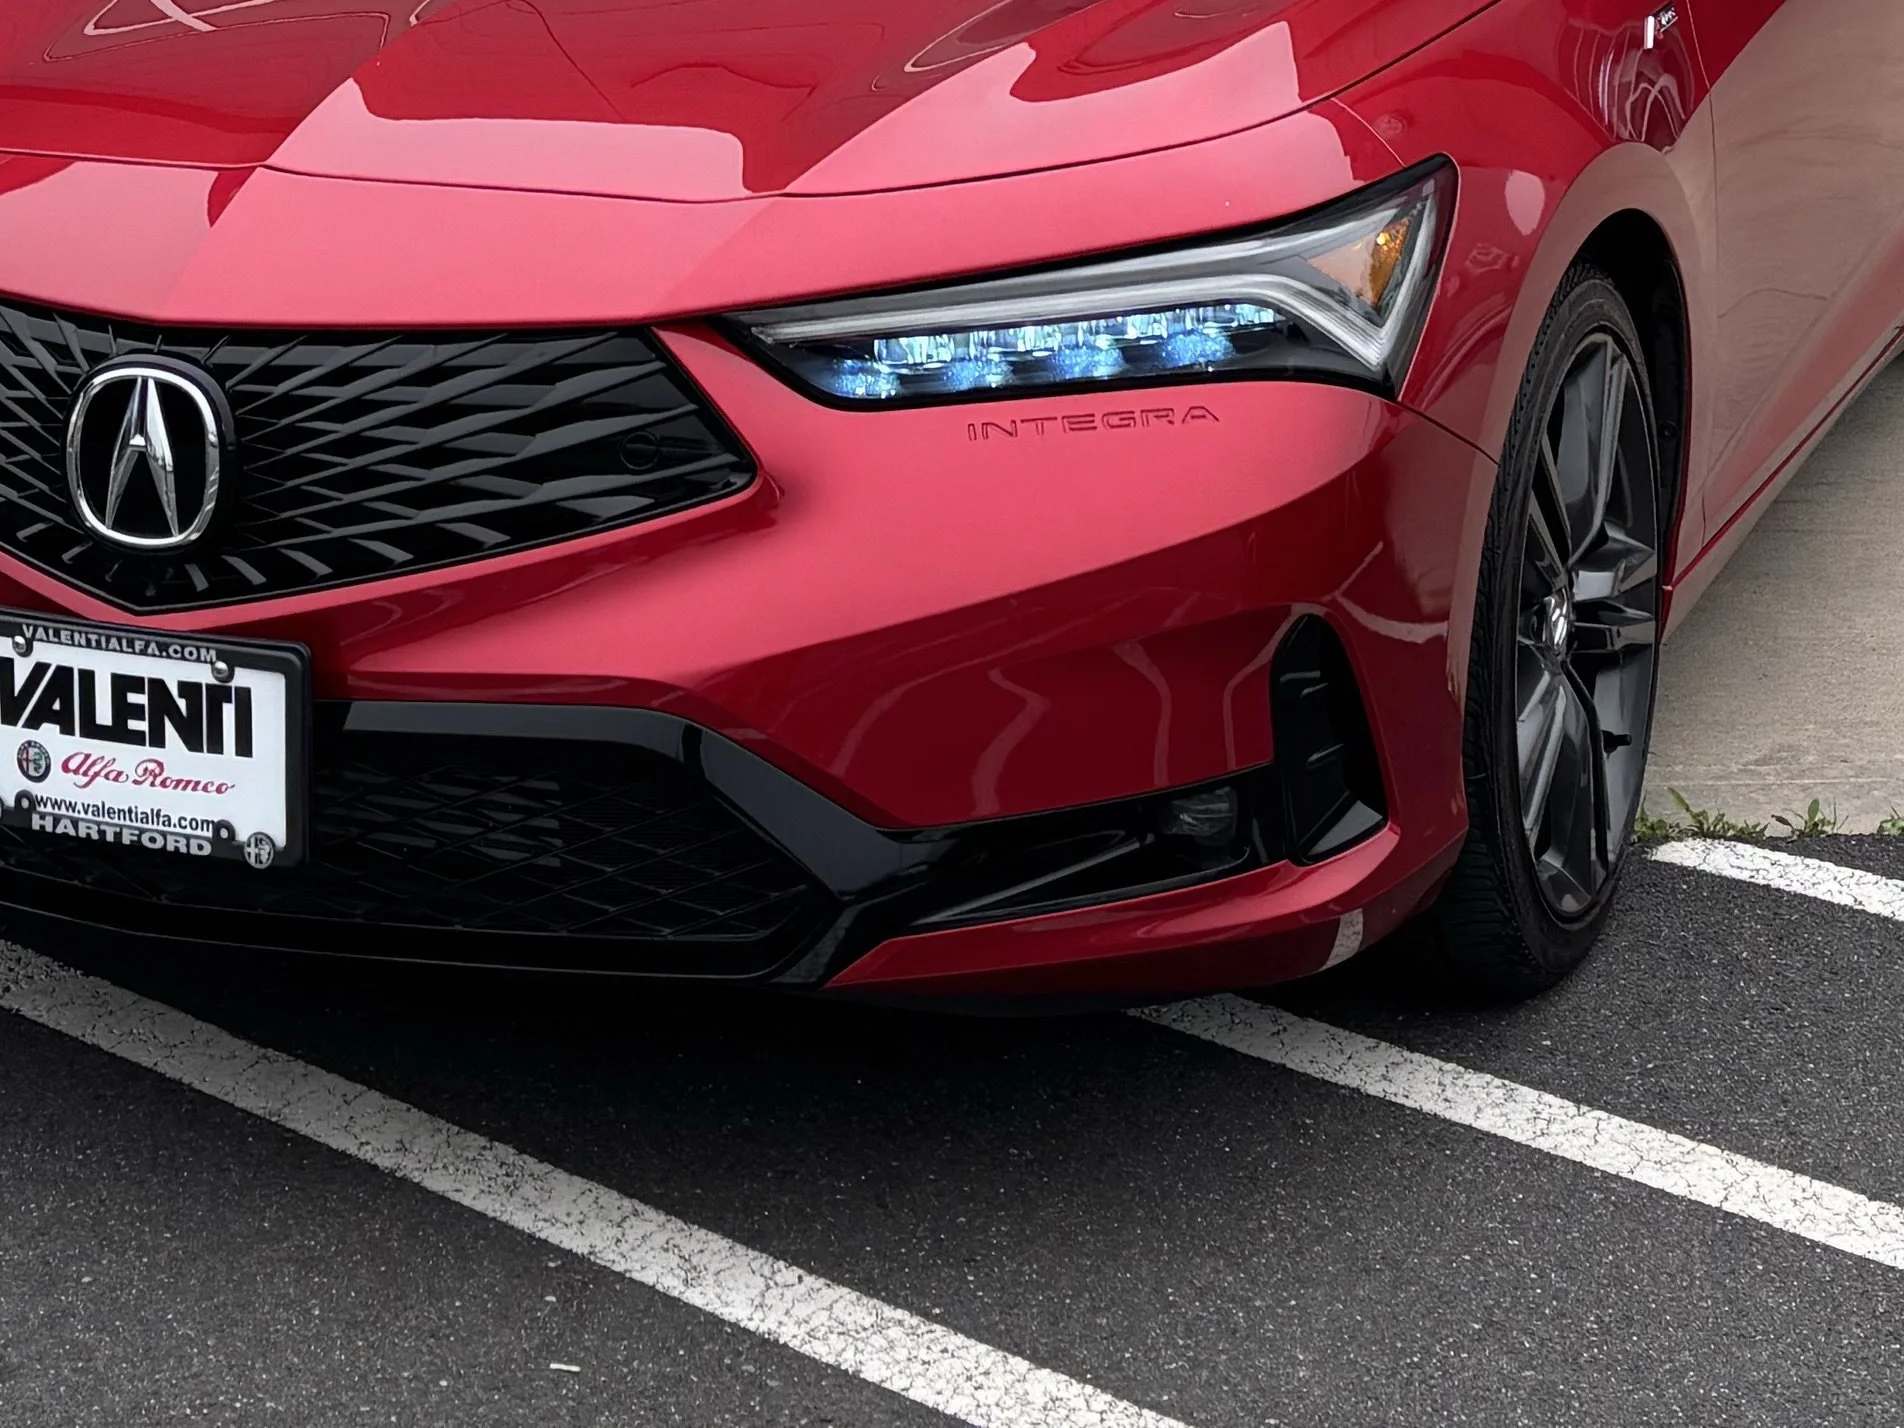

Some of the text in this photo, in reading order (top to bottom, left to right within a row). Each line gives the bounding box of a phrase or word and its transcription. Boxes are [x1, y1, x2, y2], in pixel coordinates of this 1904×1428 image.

[967, 405, 1220, 442] INTEGRA
[22, 624, 216, 662] VALENTIALFA.COM
[61, 751, 129, 789] Alfa
[132, 758, 235, 795] Romeo
[35, 794, 216, 833] www.valentialfa.com
[32, 814, 212, 857] HARTFORD
